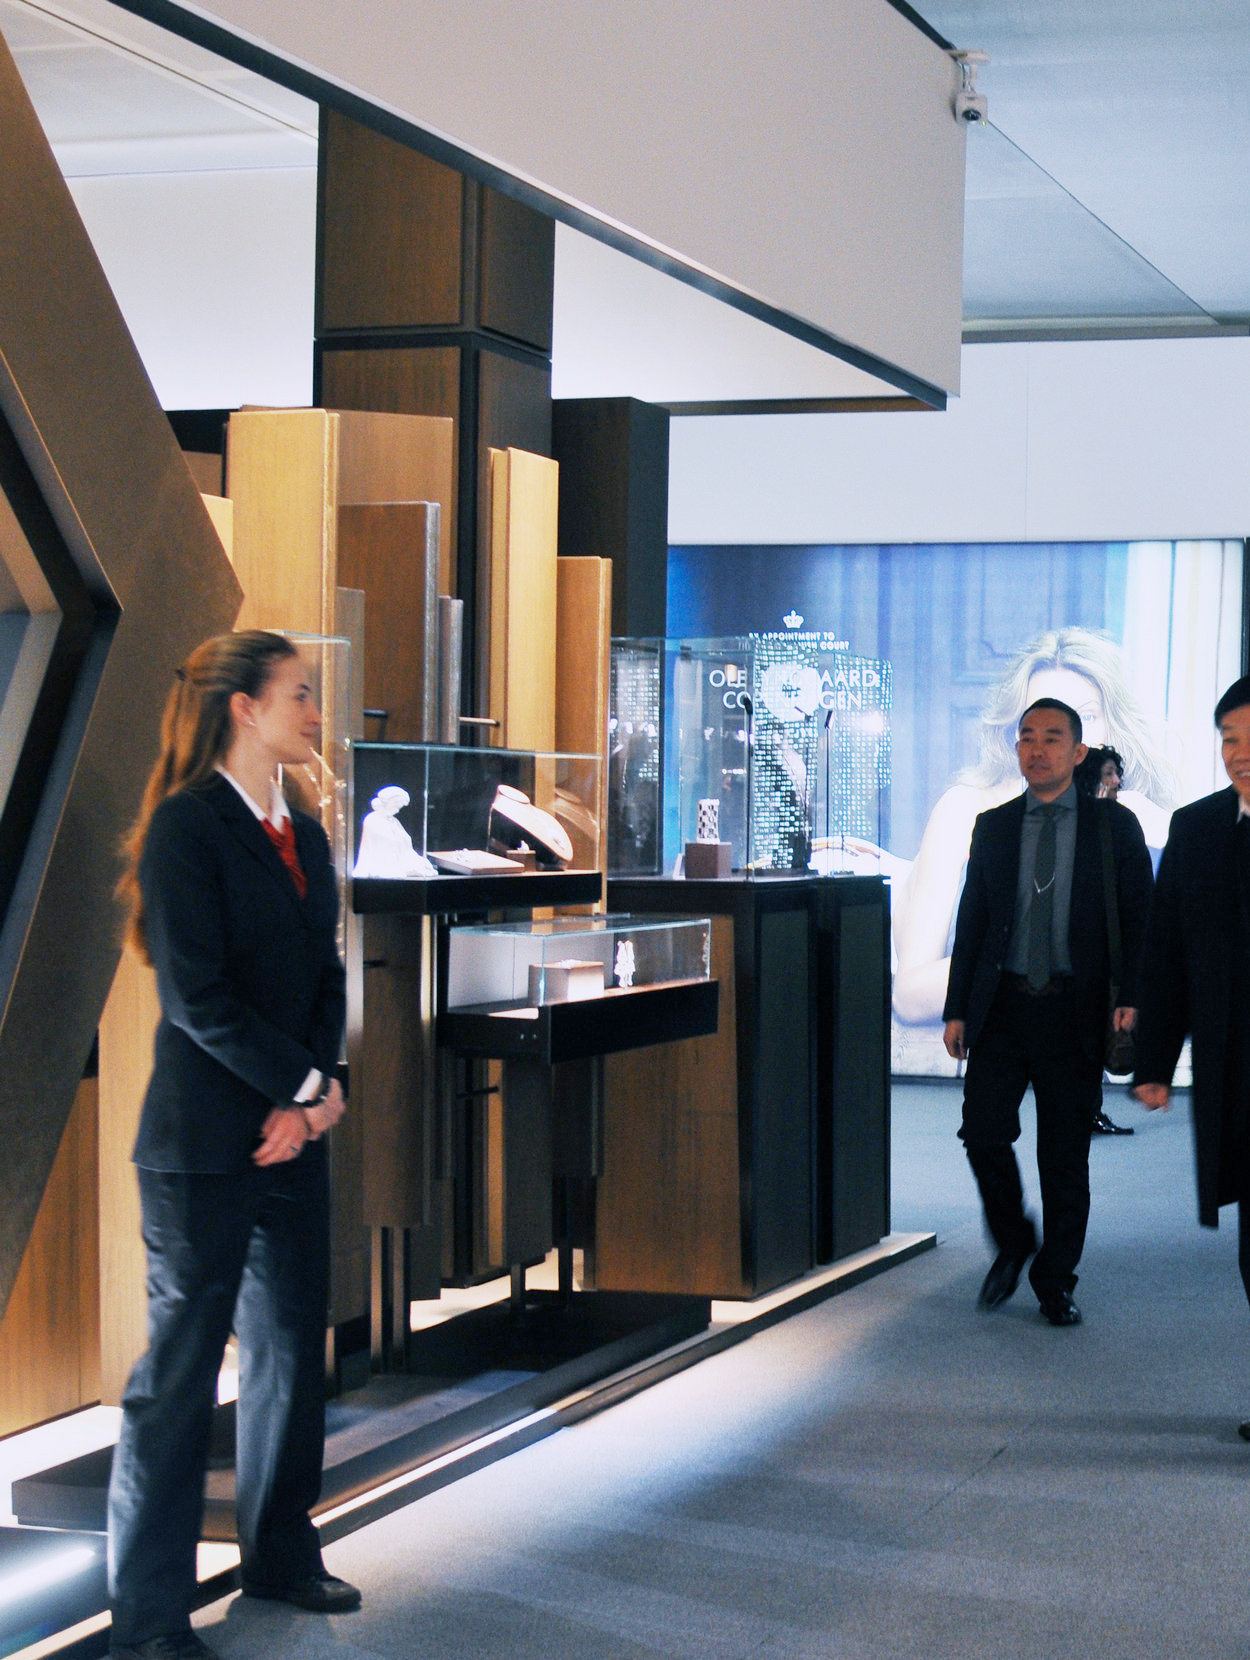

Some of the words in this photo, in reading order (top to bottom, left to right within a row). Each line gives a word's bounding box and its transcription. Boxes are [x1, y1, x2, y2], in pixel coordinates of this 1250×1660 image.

[762, 632, 820, 641] APPOINTMENT
[823, 632, 835, 641] TO
[820, 641, 849, 651] COURT
